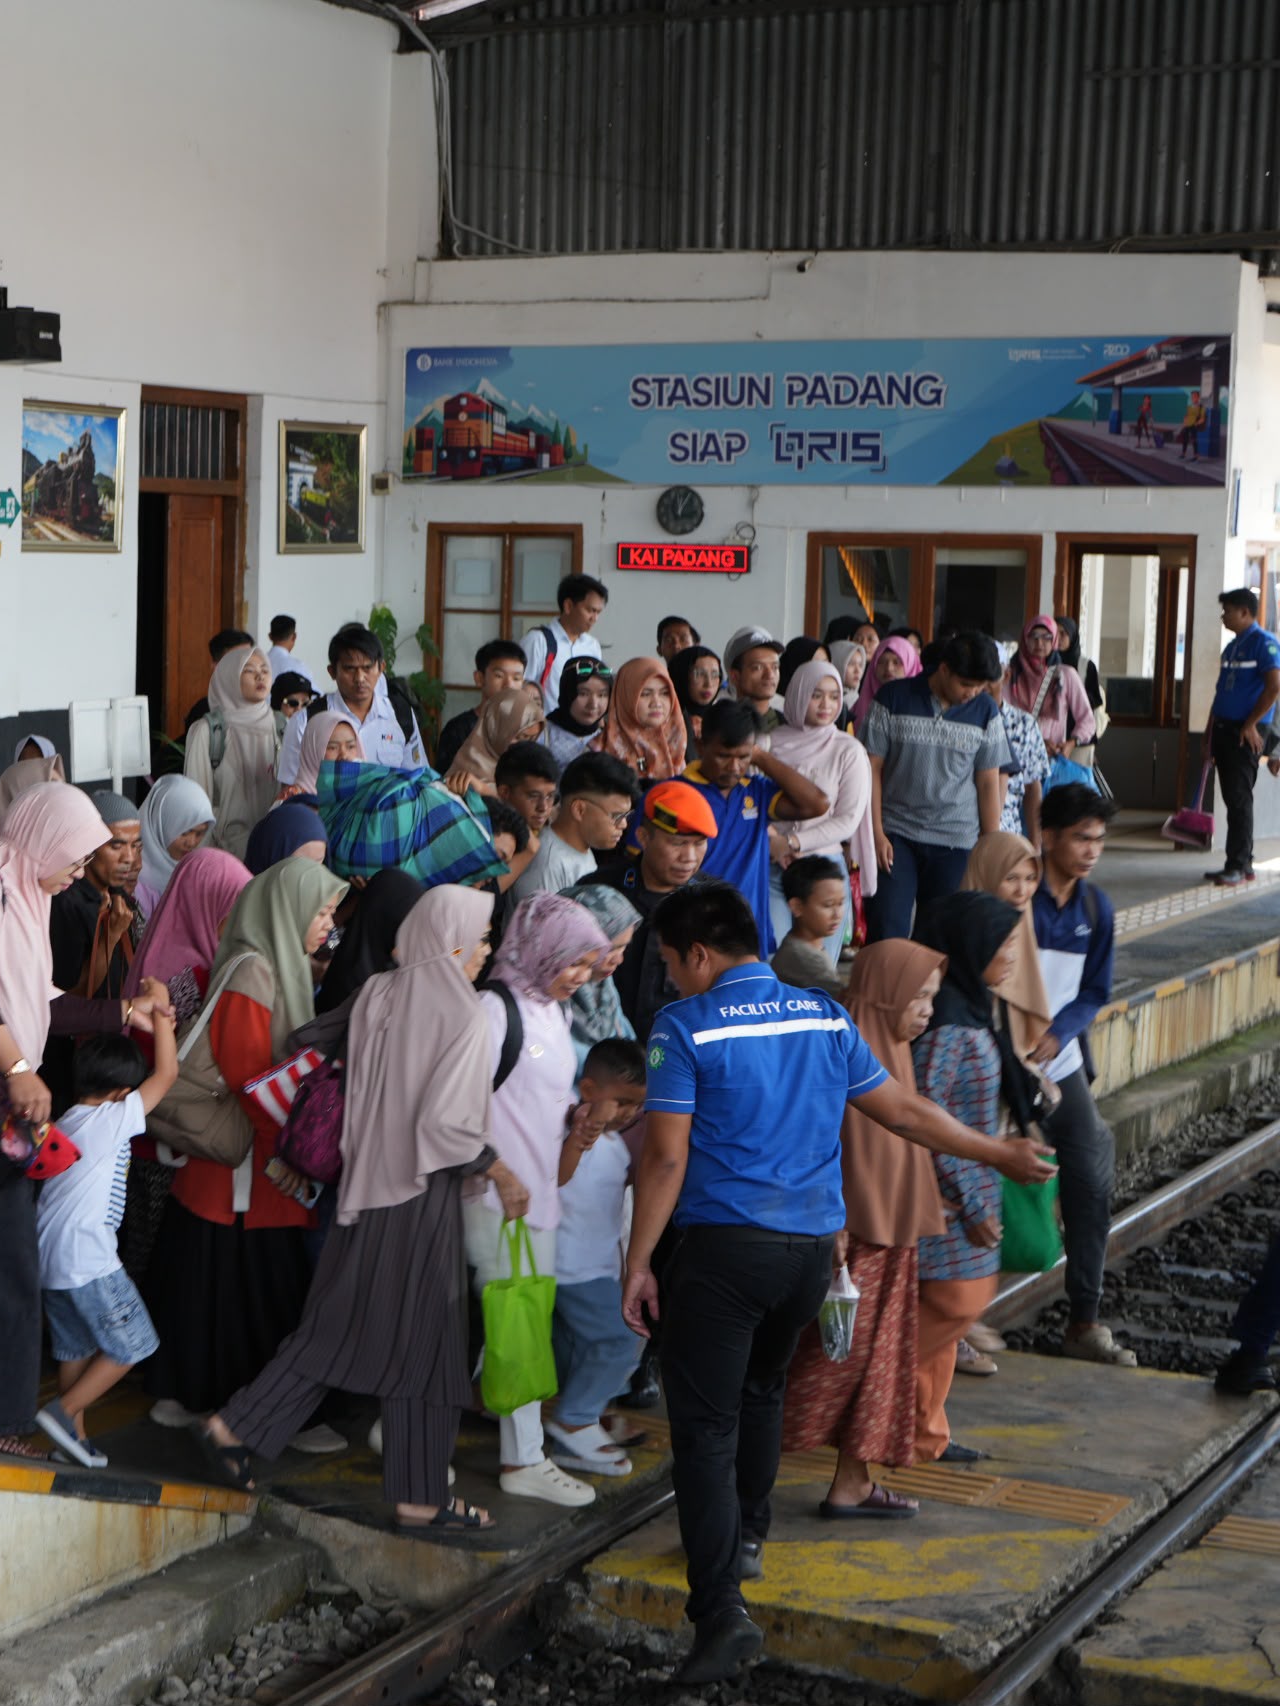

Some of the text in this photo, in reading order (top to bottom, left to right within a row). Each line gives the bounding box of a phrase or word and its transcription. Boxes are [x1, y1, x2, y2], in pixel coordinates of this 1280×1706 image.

[630, 373, 945, 408] STASIUN PADANG
[668, 428, 883, 471] SIAP QRIS
[630, 548, 736, 568] KAI PADANG
[719, 999, 823, 1018] FACILITY CARE
